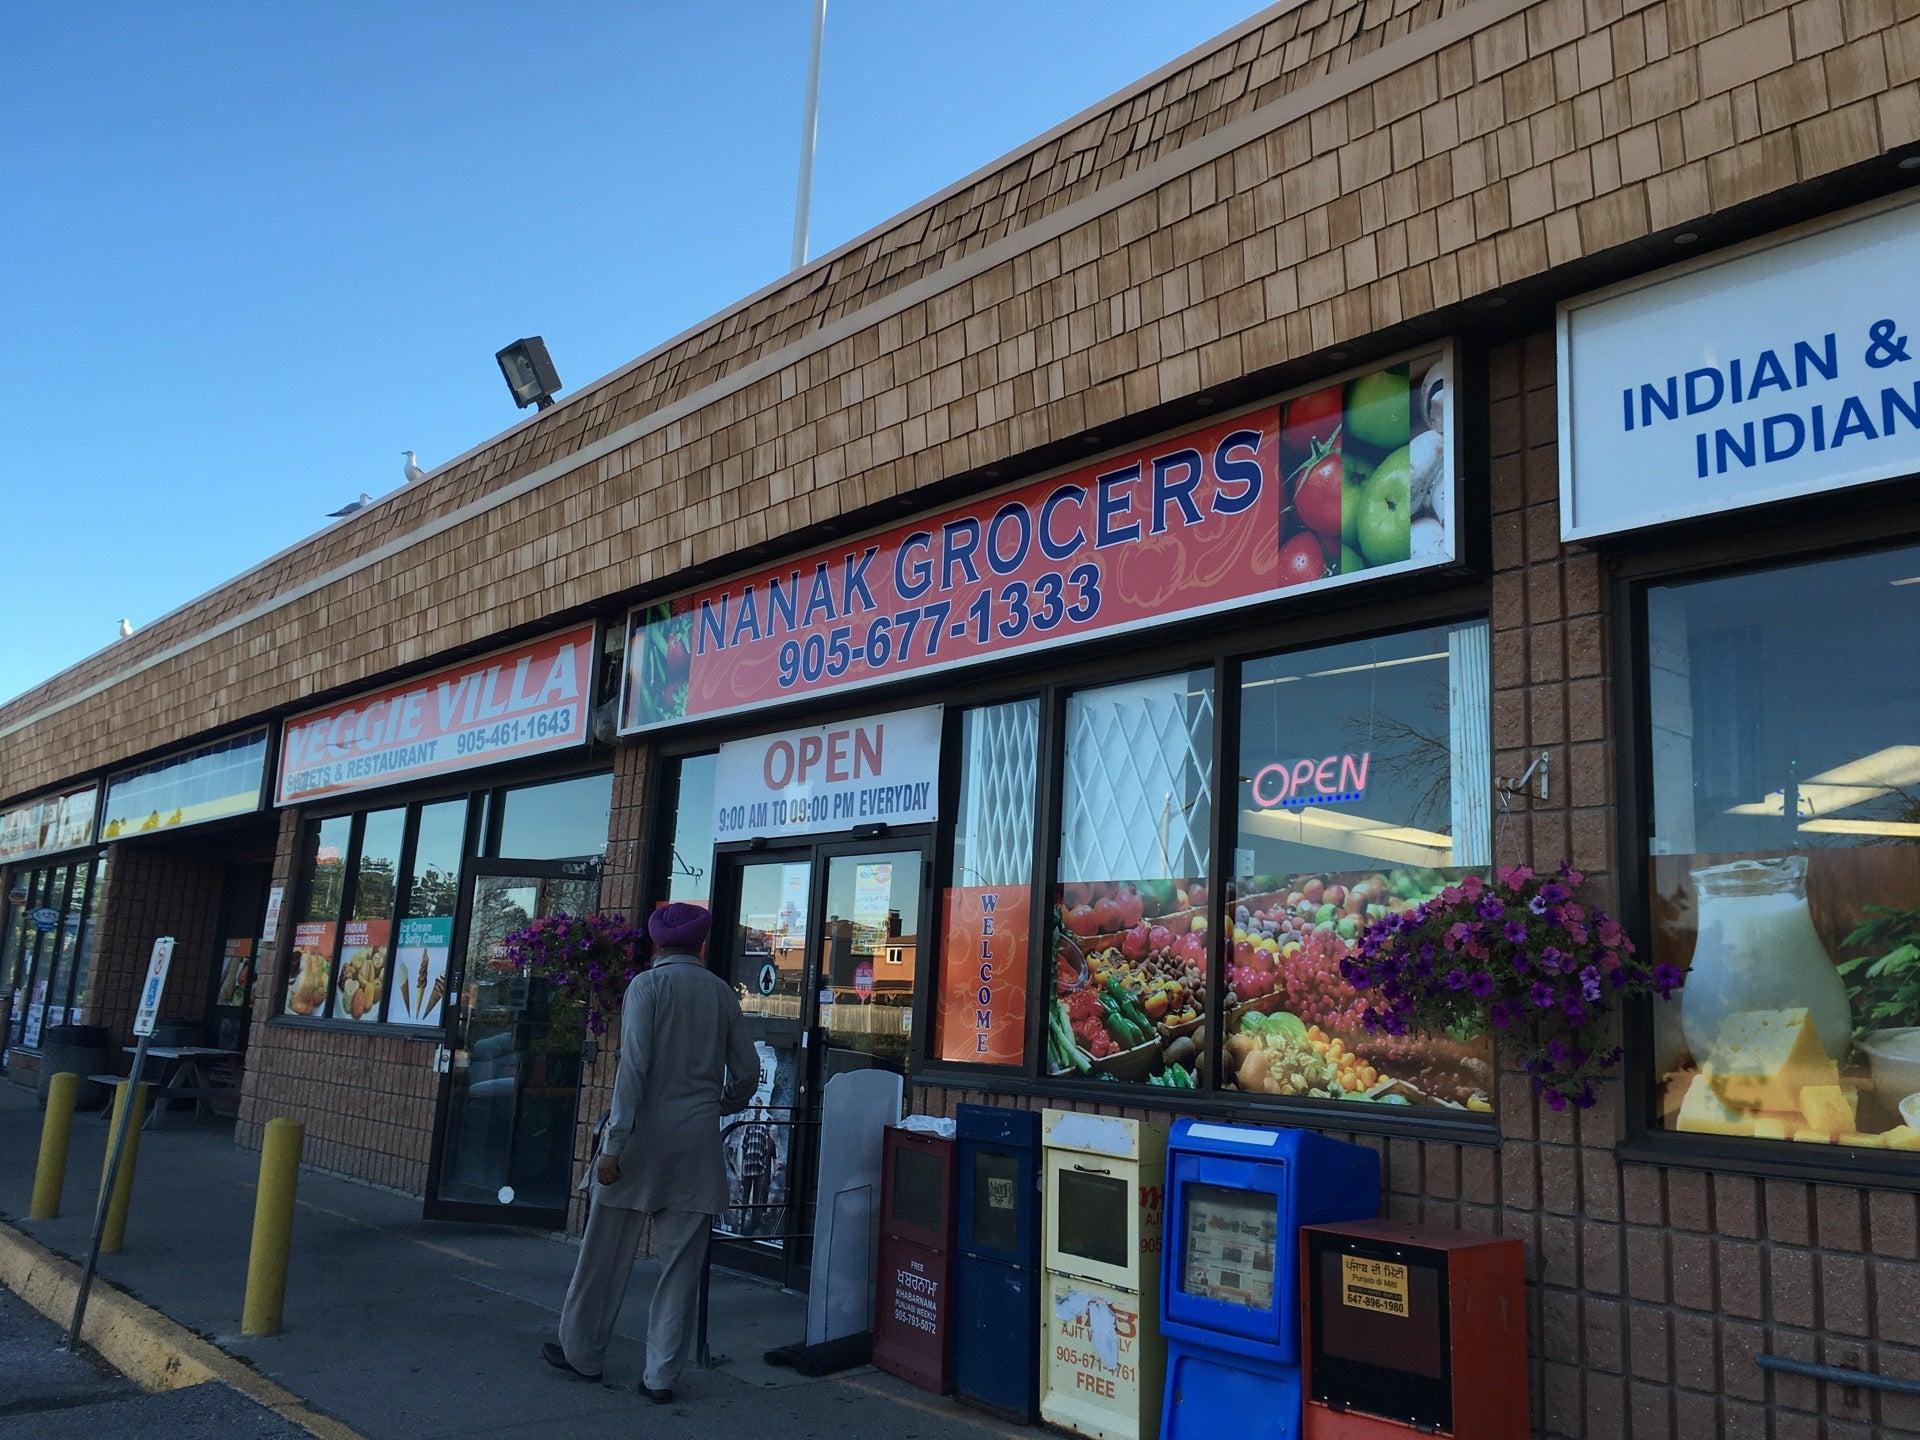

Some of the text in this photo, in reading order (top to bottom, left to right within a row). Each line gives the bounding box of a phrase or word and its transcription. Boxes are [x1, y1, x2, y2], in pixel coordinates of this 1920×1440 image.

[1623, 318, 1912, 431] INDIAN &
[1696, 380, 1920, 478] INDIAN
[697, 429, 1265, 656] NANAK GROCERS
[778, 563, 1102, 689] 905-677-1333
[288, 643, 580, 768] VEGGIE VILLA
[334, 767, 342, 781] &
[346, 741, 438, 777] RESTAURANT
[457, 709, 570, 755] 905-461-1643
[763, 724, 884, 790] OPEN
[1252, 752, 1369, 807] OPEN
[719, 782, 930, 831] 9:00 AM TO 09:00 PM EVERYDAY
[343, 934, 368, 945] SWEETS
[411, 922, 432, 932] Cream
[423, 934, 443, 944] Cones
[976, 894, 999, 1053] WELCOME
[911, 1260, 924, 1272] FREE
[1352, 1274, 1375, 1285] Punjab
[895, 1299, 937, 1322] PUNJABI WEEKLY
[896, 1288, 937, 1311] KHABARNAMA
[1347, 1293, 1404, 1313] 647-896-1980
[895, 1309, 937, 1335] 905-793-5072
[1062, 1323, 1085, 1340] AJIT
[1076, 1371, 1115, 1399] FREE
